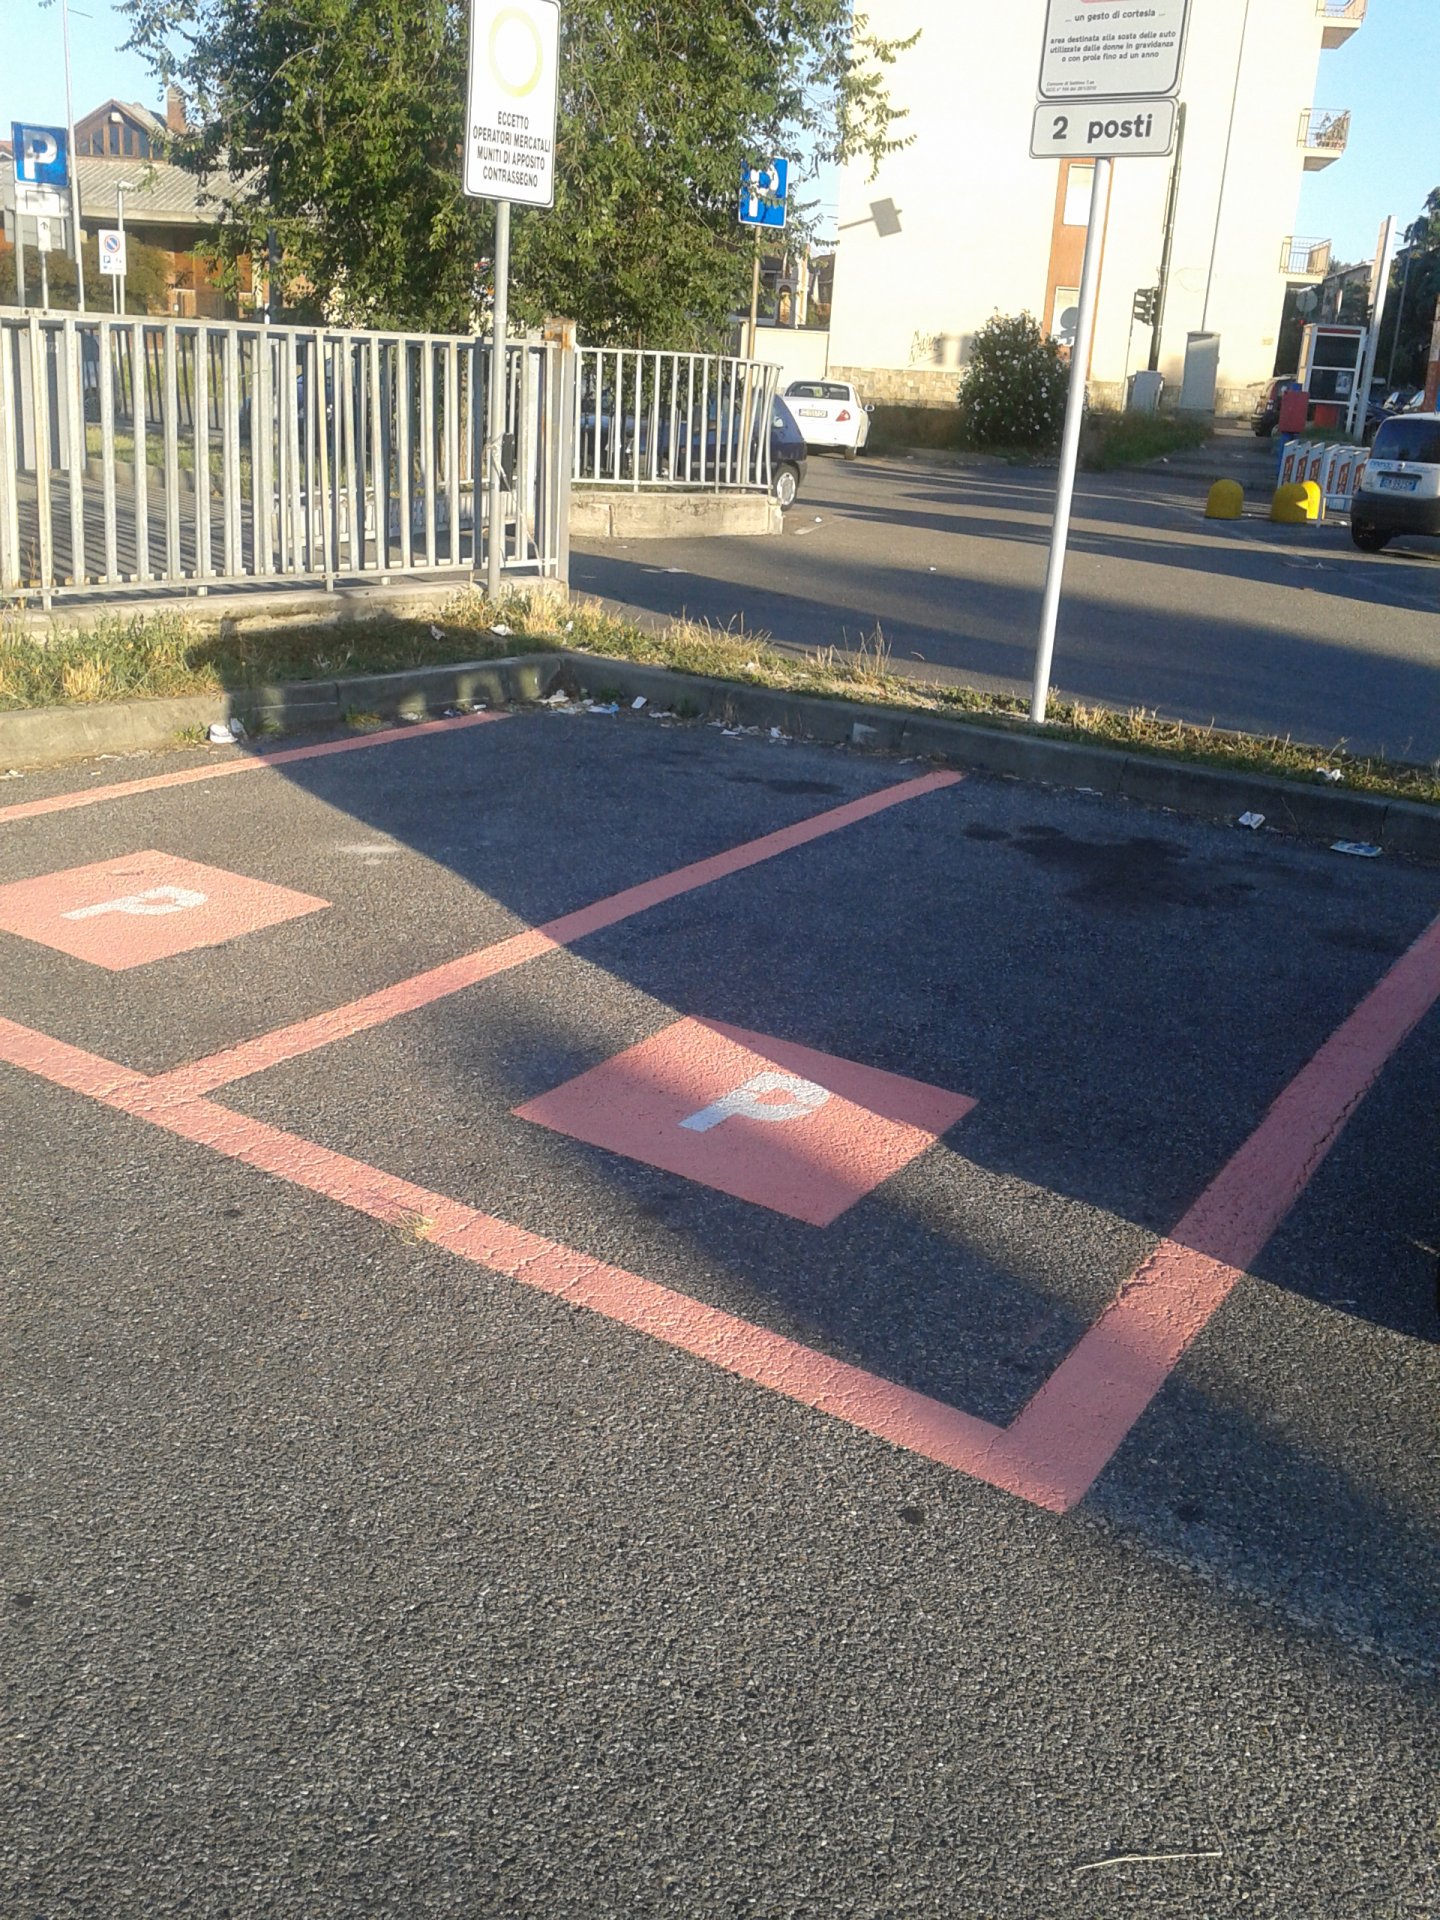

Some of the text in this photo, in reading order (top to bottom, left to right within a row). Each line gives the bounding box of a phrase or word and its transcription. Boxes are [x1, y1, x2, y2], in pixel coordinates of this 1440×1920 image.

[1087, 12, 1110, 22] gesto
[1112, 10, 1120, 19] di
[1122, 9, 1156, 18] cortesia
[1050, 41, 1174, 53] utilizzate dalle donne in gravidanza
[1067, 34, 1100, 43] destinata
[1101, 33, 1115, 41] alla
[1139, 31, 1157, 39] delle
[1082, 53, 1101, 62] prole
[1102, 52, 1117, 60] fino
[1119, 51, 1128, 59] ad
[498, 111, 529, 130] ECCETTO
[1052, 113, 1153, 144] 2 posti
[473, 125, 551, 153] OPERATORI MERCATALI
[23, 129, 57, 179] P
[477, 145, 545, 170] MUNITI DI APPOSITO
[483, 165, 538, 188] CONTRASSEGNO
[748, 164, 779, 217] P
[678, 1071, 830, 1133] P
